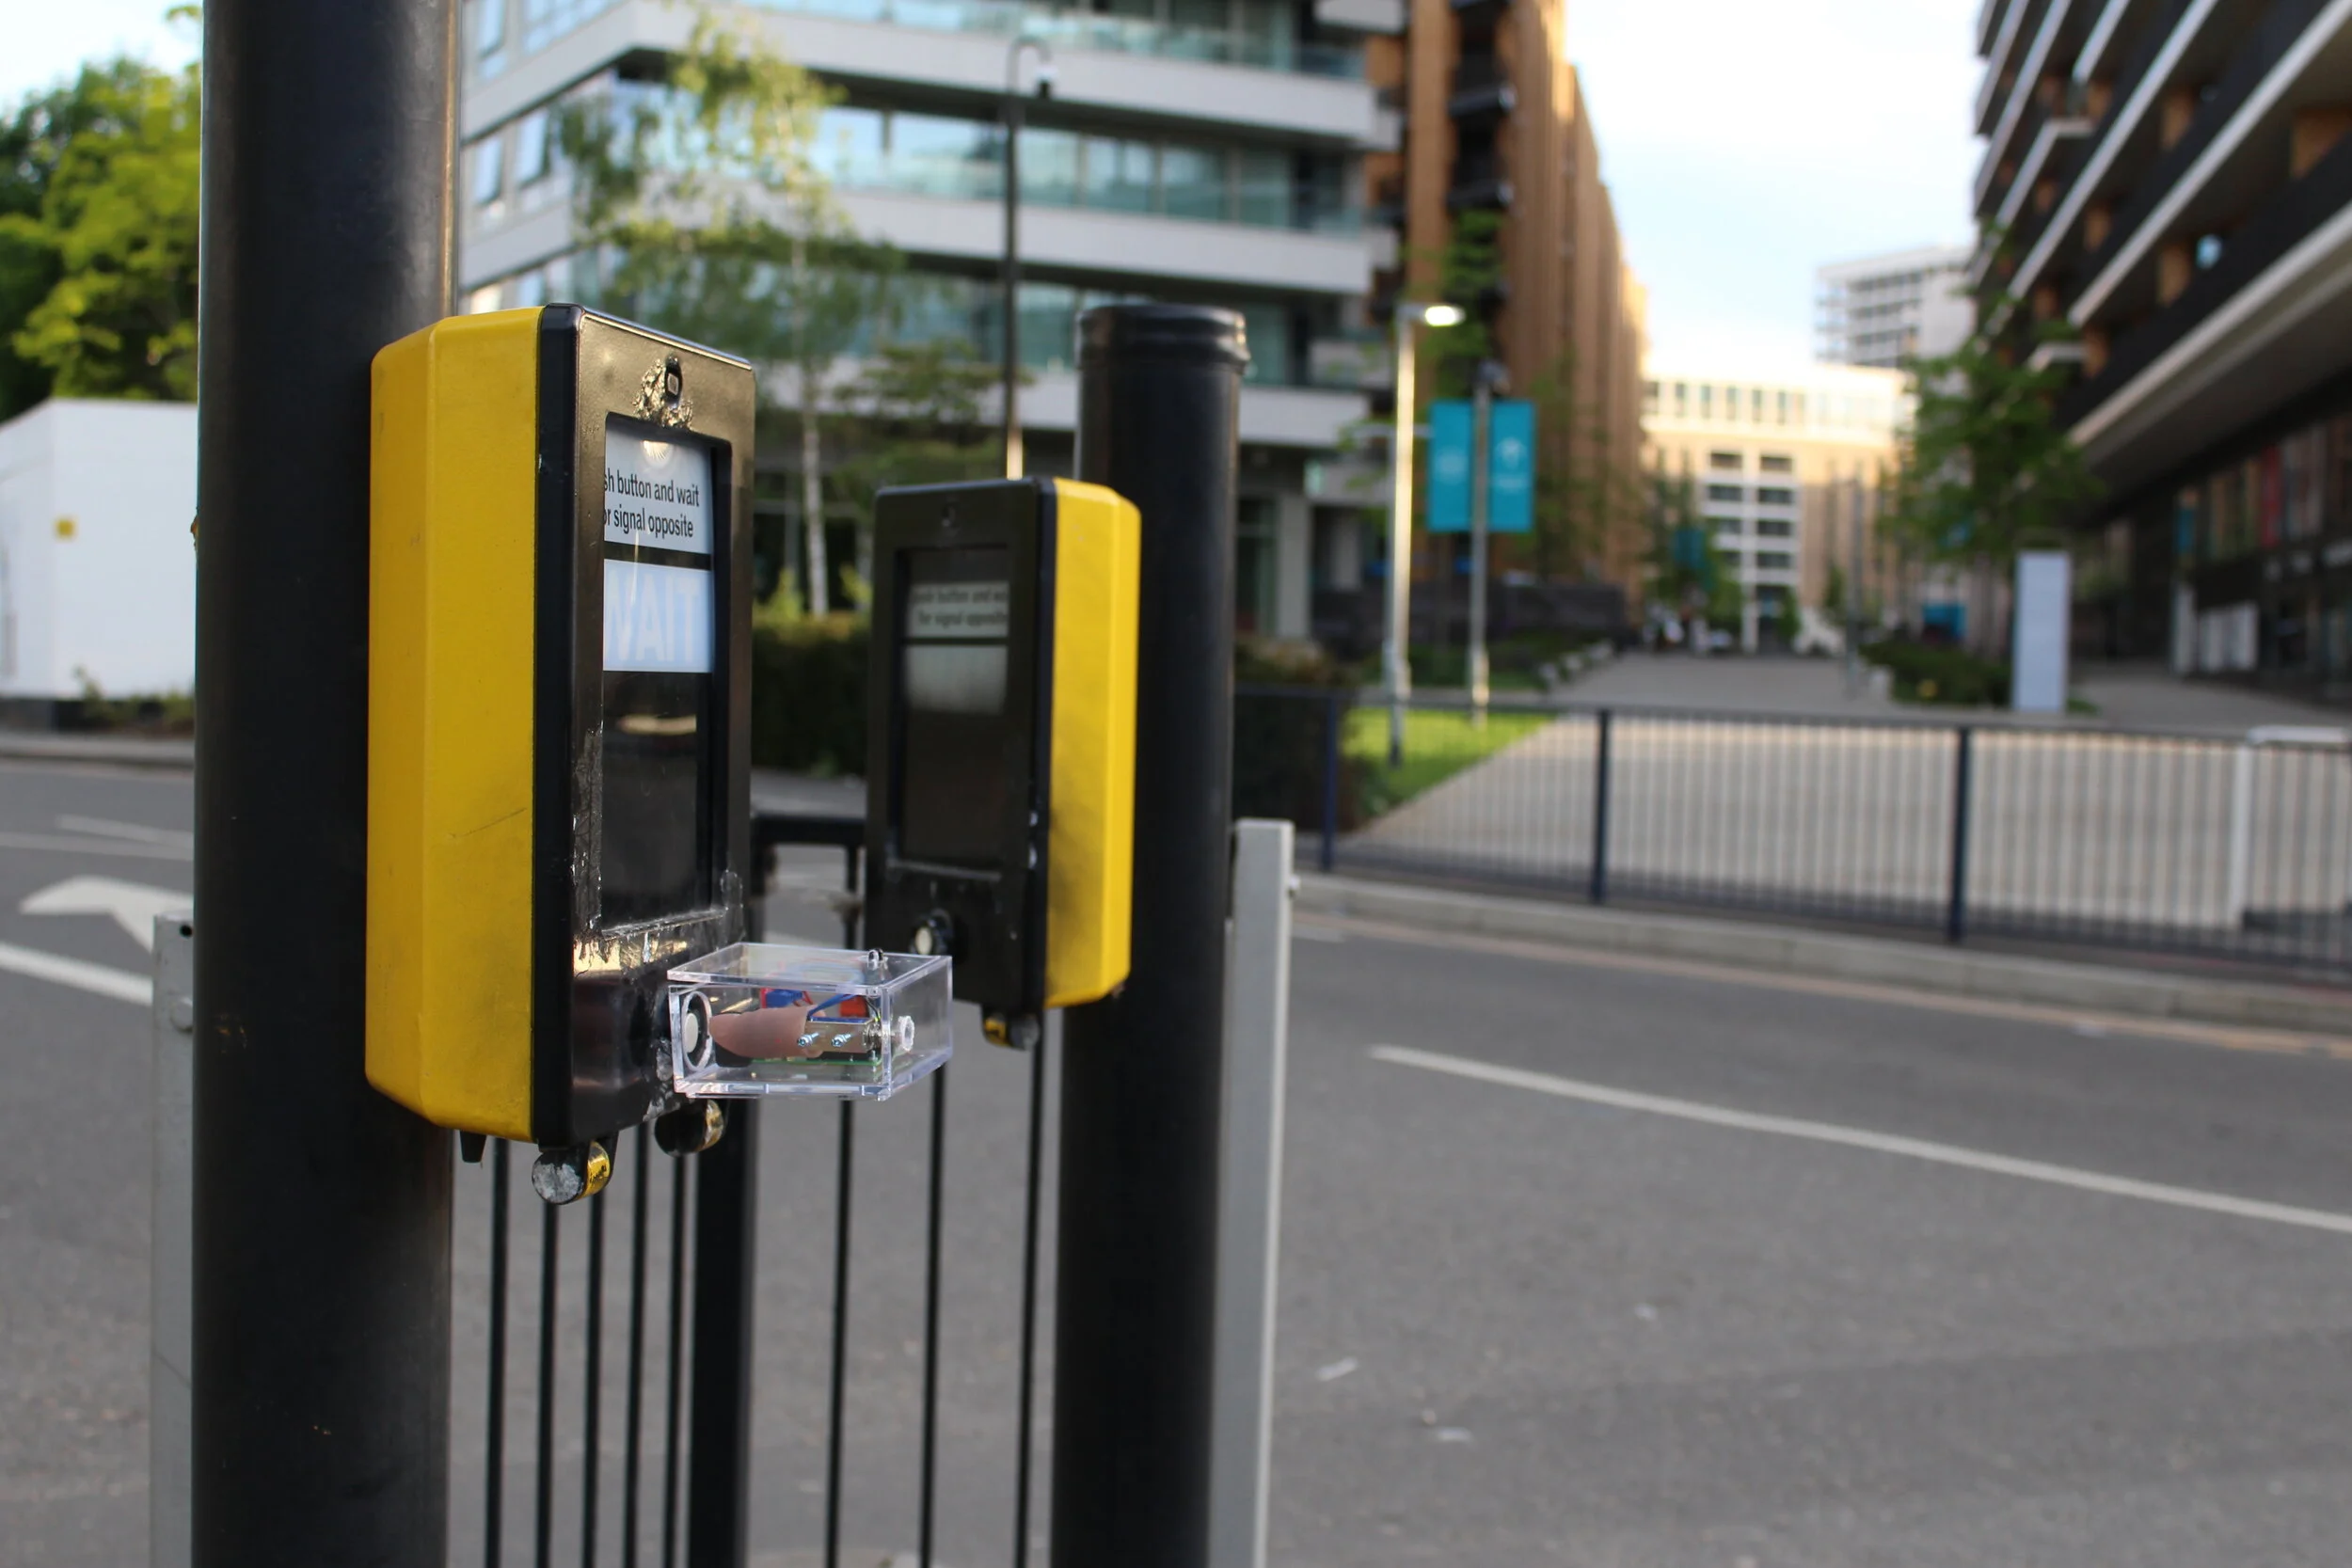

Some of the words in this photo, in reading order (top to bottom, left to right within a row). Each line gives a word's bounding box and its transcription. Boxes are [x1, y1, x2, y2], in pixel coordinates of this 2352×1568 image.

[617, 469, 652, 499] button
[654, 480, 675, 502] and
[676, 483, 700, 507] wait
[613, 504, 646, 534] signal
[647, 514, 694, 539] opposite
[604, 568, 700, 663] WAIT
